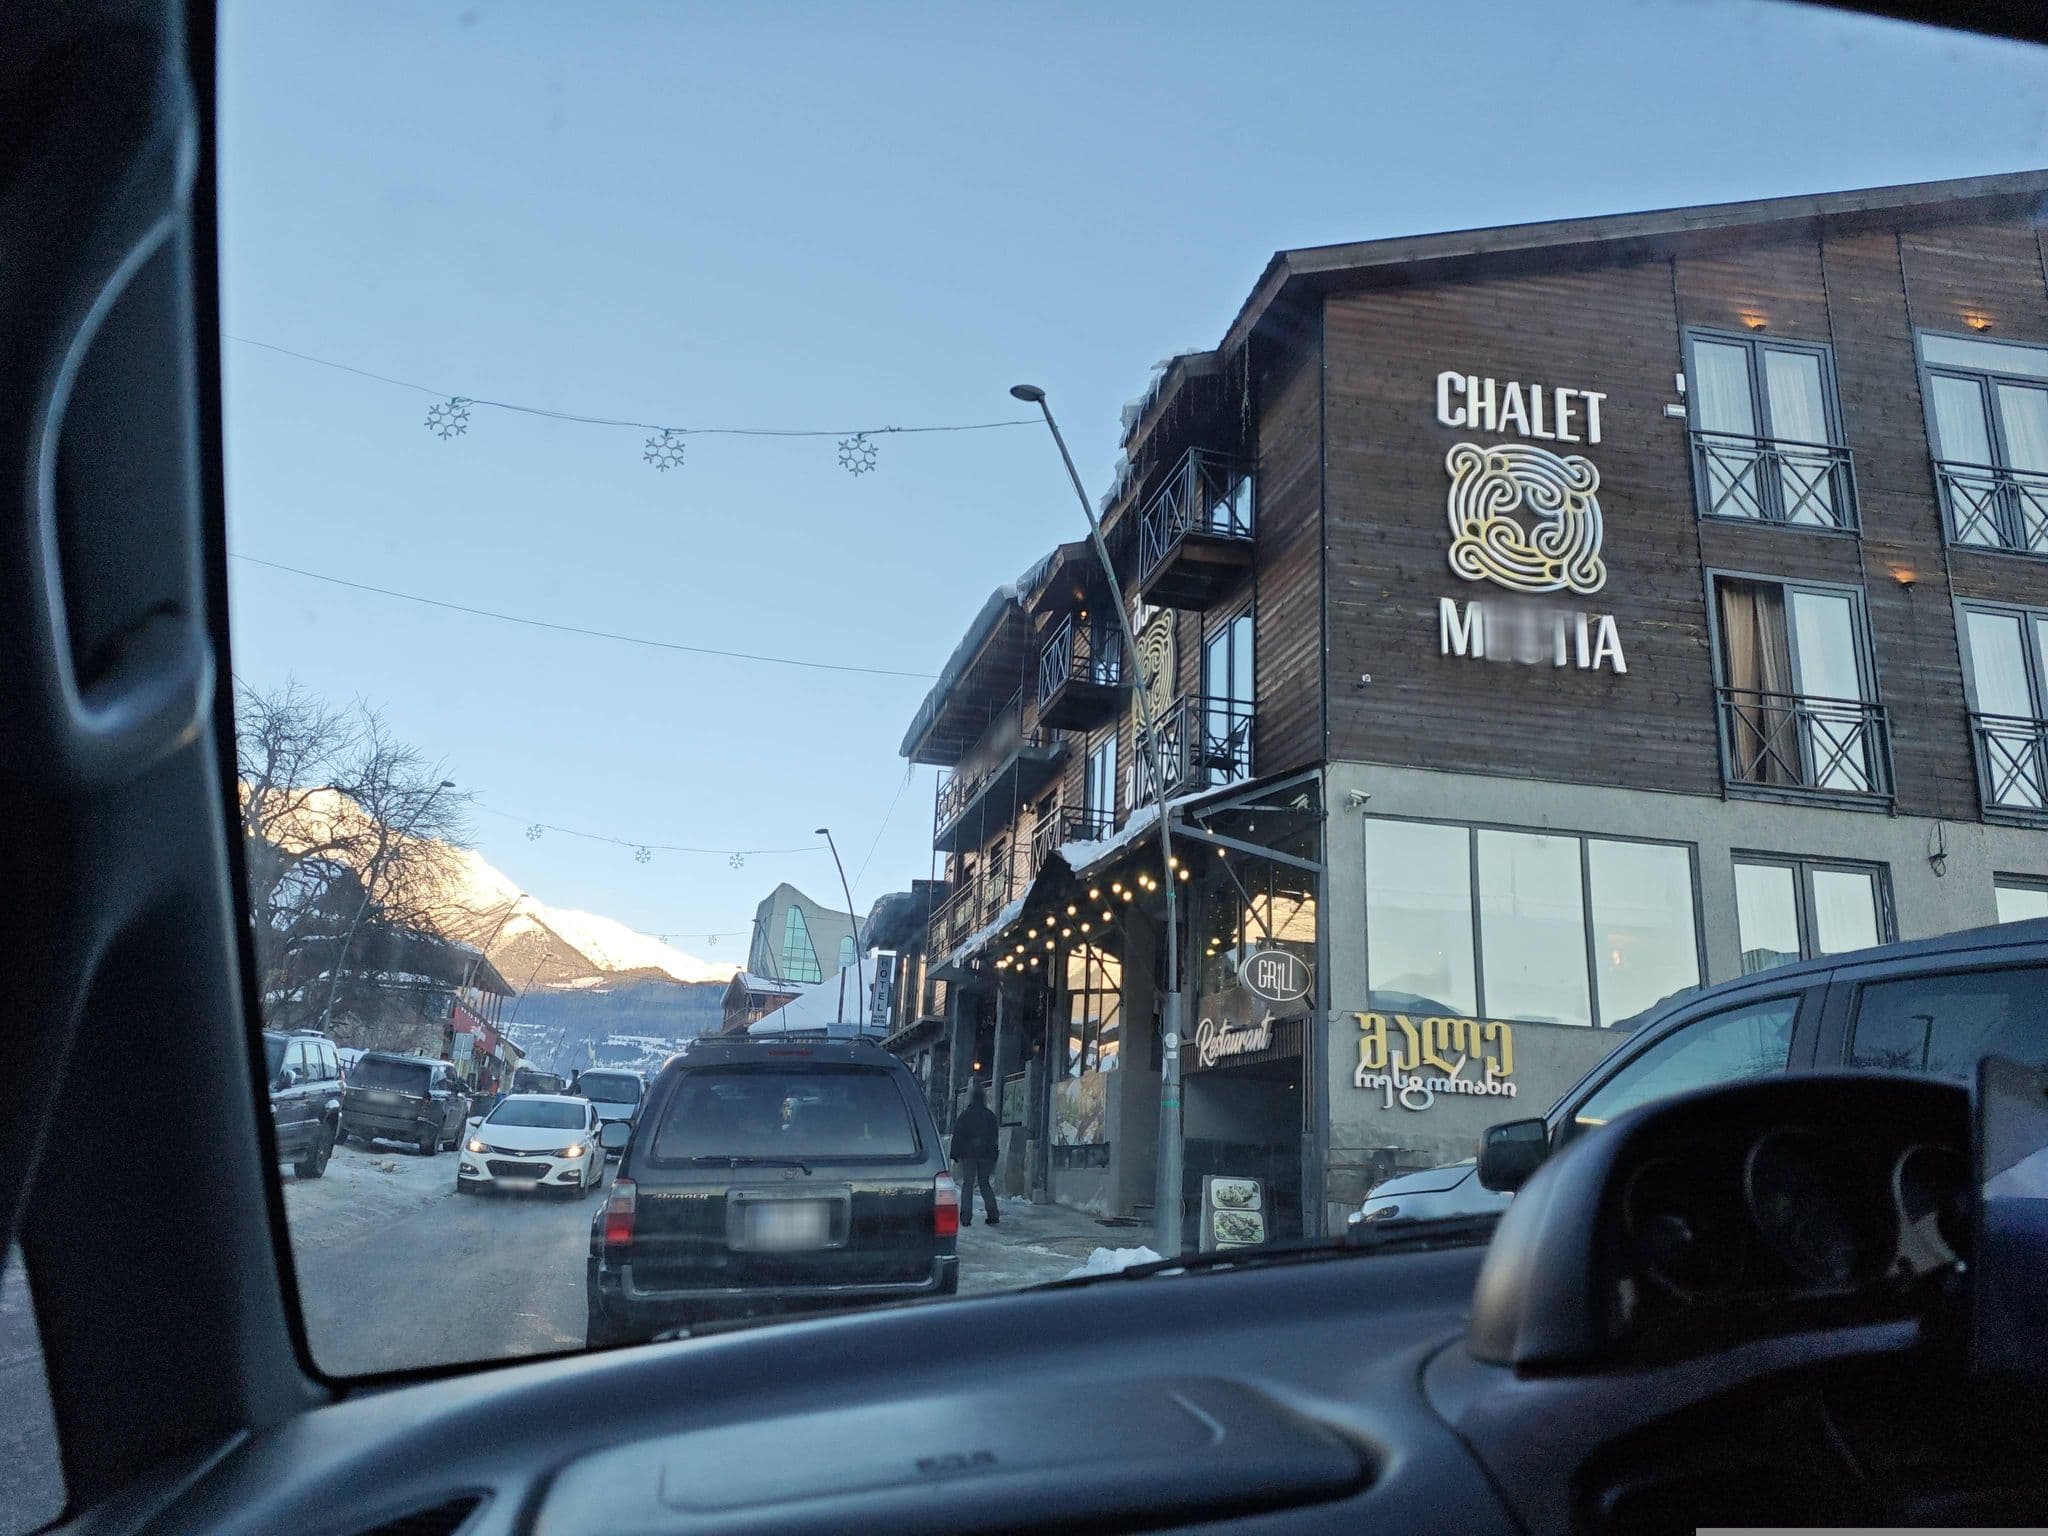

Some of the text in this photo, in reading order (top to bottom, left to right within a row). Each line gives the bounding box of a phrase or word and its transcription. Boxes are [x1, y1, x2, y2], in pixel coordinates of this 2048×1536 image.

[1437, 371, 1607, 445] CHALET
[1440, 597, 1628, 674] MTIA
[877, 959, 888, 1012] HOTEL
[1257, 955, 1298, 999] GRILL
[1195, 1009, 1276, 1068] Restaurant
[1354, 1012, 1514, 1077] შალე
